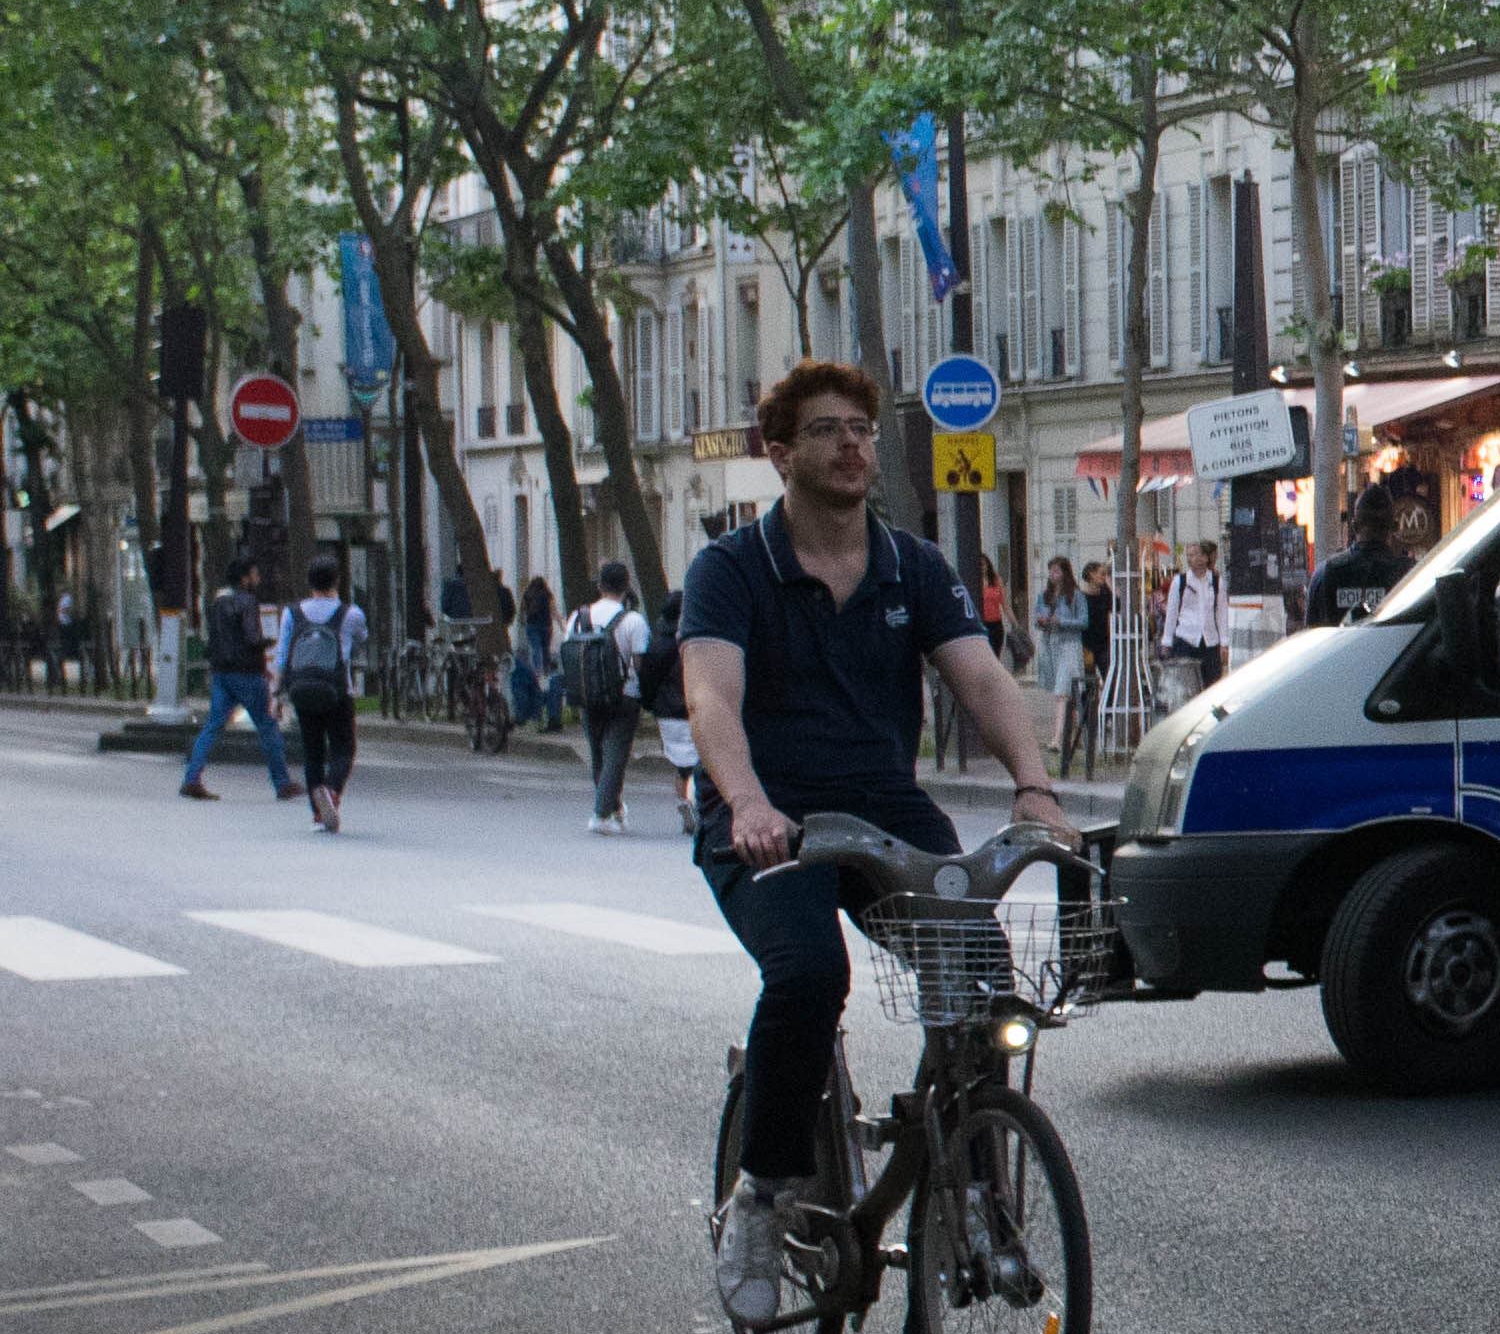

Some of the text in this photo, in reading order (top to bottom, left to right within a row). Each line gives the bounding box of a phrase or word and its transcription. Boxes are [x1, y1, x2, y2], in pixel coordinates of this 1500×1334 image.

[1213, 406, 1260, 423] PIETONS
[1209, 419, 1269, 439] ATTENTION
[1230, 438, 1252, 450] BUS
[1212, 453, 1255, 470] CONTRE
[1258, 447, 1287, 461] SENS
